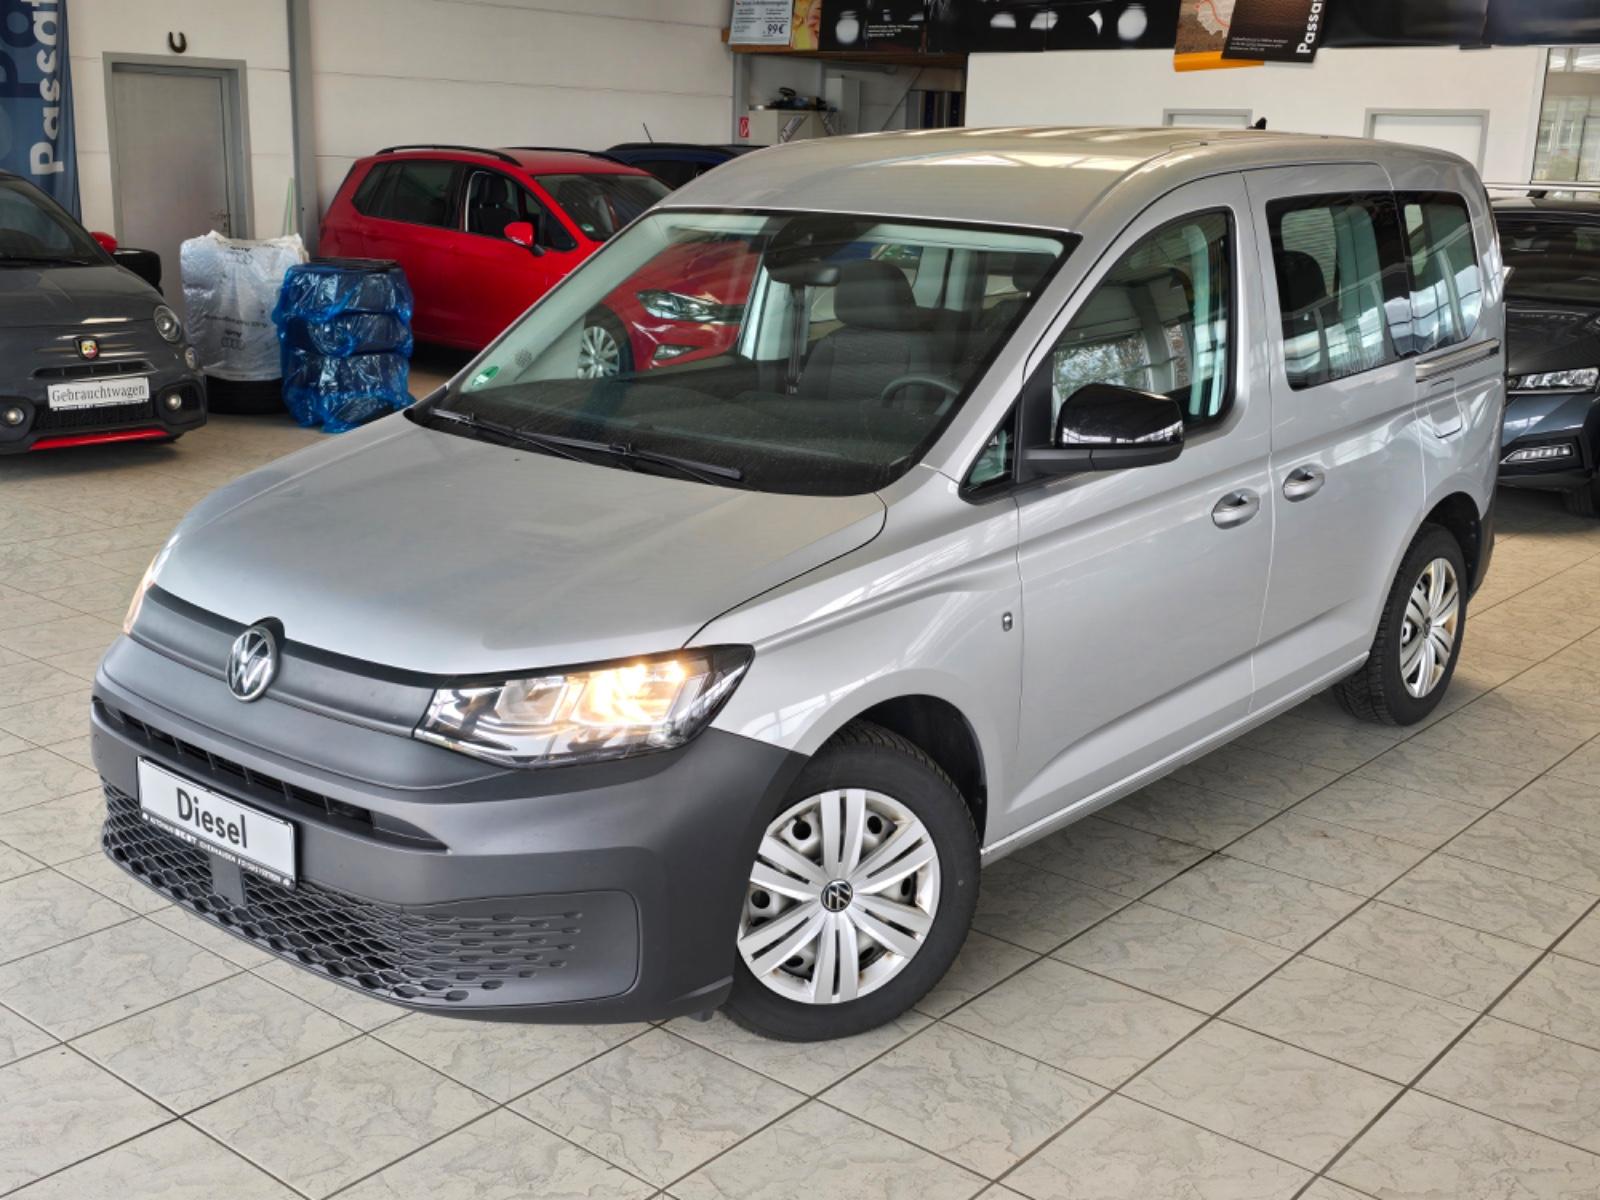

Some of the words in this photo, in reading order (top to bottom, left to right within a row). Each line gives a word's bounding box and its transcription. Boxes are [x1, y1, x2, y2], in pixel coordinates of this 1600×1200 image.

[1296, 0, 1322, 53] Passa
[52, 385, 145, 402] Gebrauchtwagen
[176, 787, 247, 848] Diesel
